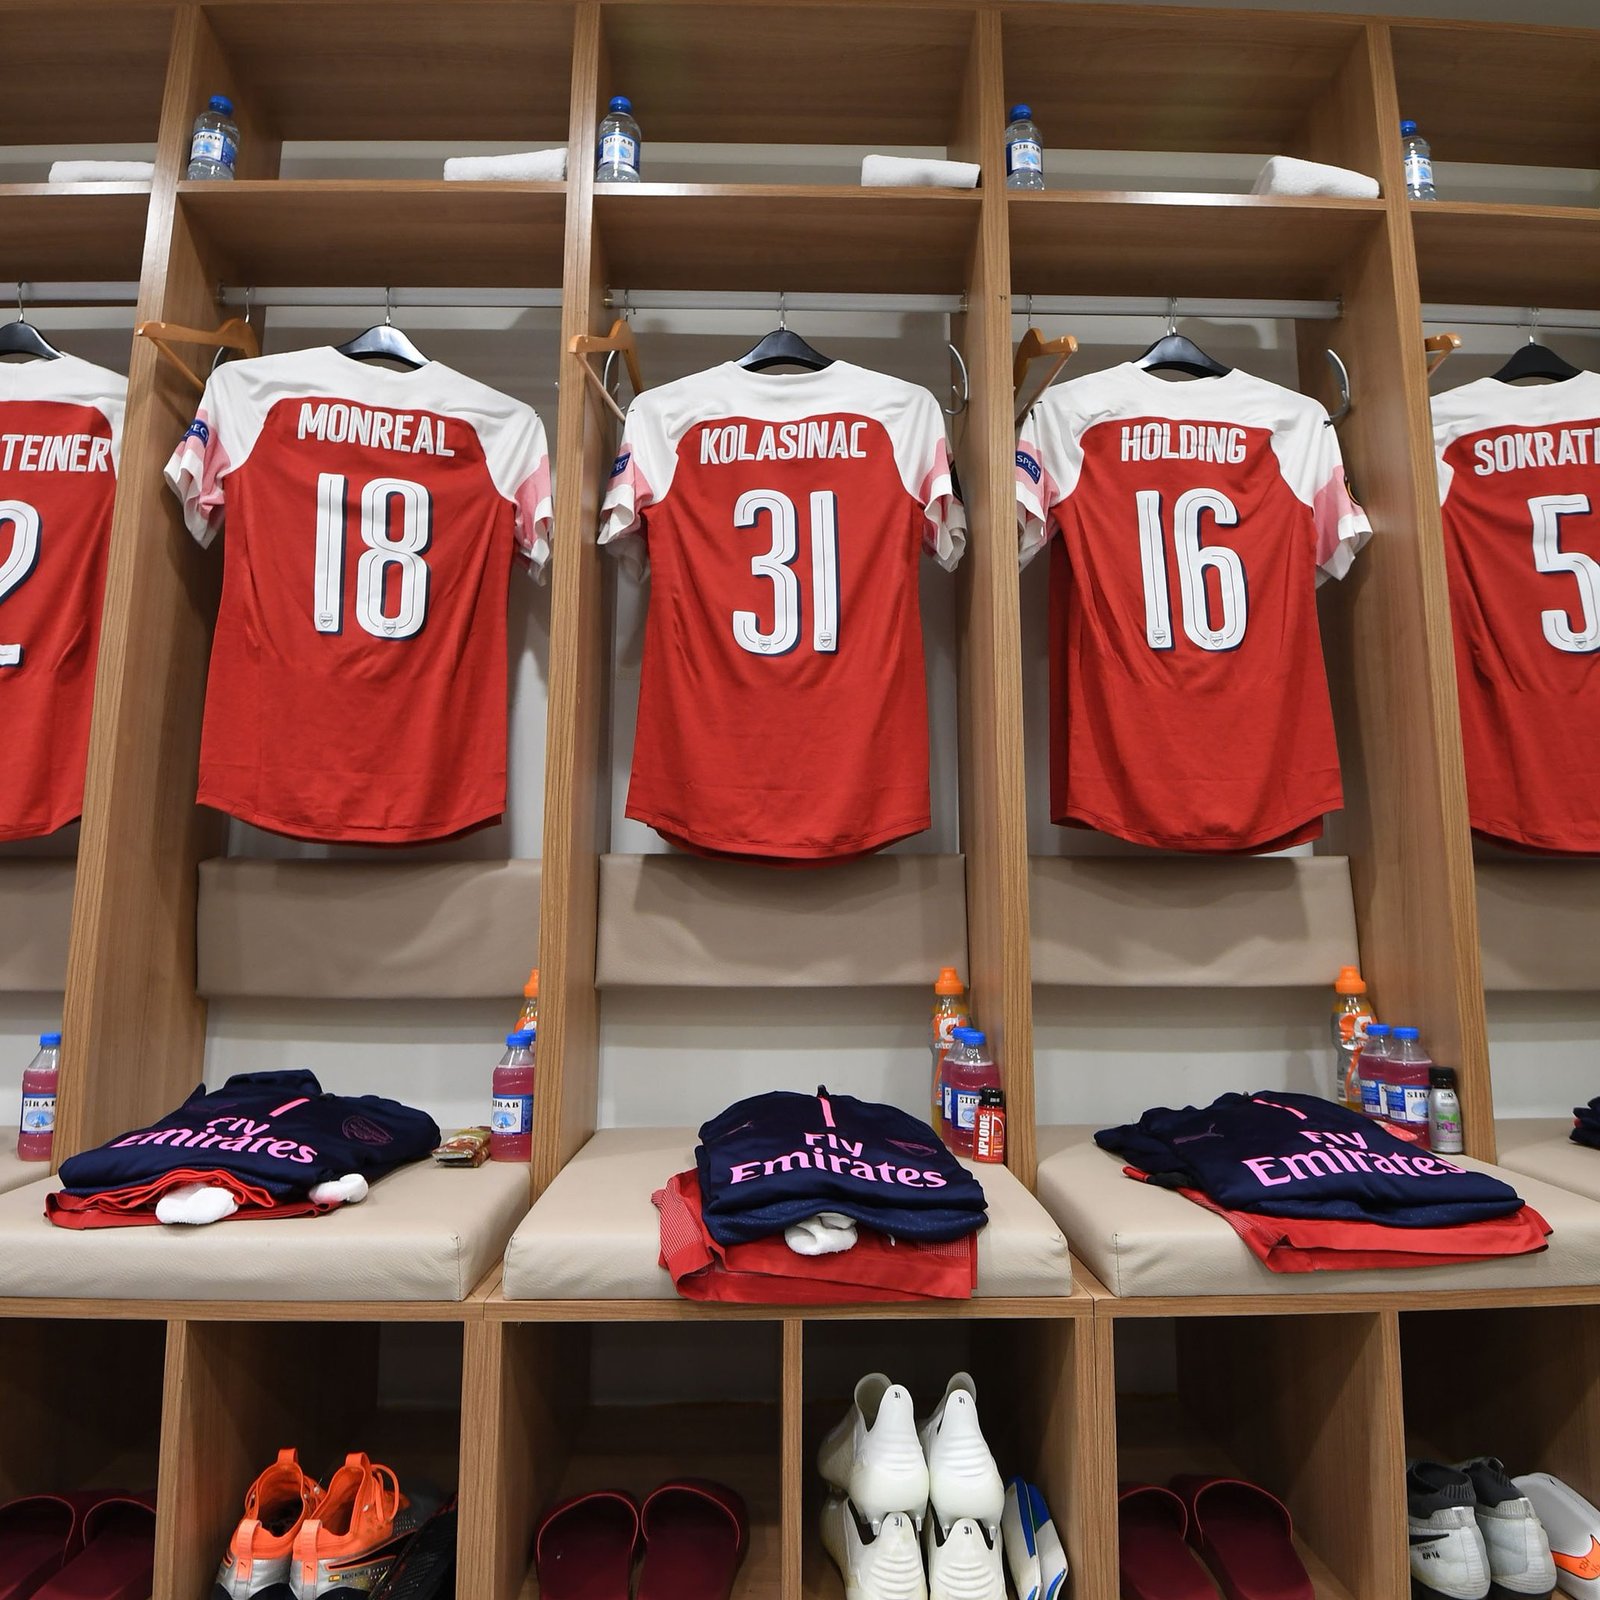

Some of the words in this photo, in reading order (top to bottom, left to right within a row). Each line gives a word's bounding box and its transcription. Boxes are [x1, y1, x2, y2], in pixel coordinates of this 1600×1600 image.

[297, 402, 456, 457] MONREAL
[700, 421, 868, 465] KOLASINAC
[1121, 422, 1247, 464] HOLDING
[0, 434, 111, 472] TEINER
[313, 472, 432, 640] 18
[732, 488, 839, 655] 31
[1135, 487, 1248, 651] 16
[1527, 493, 1600, 654] 5
[109, 1126, 317, 1164] Emirates
[206, 1116, 271, 1137] Fly
[803, 1132, 863, 1158] Fly
[978, 1112, 990, 1157] XPLODE
[1299, 1130, 1369, 1150] Fly
[730, 1148, 947, 1188] Emirates
[1242, 1143, 1467, 1188] Emirates
